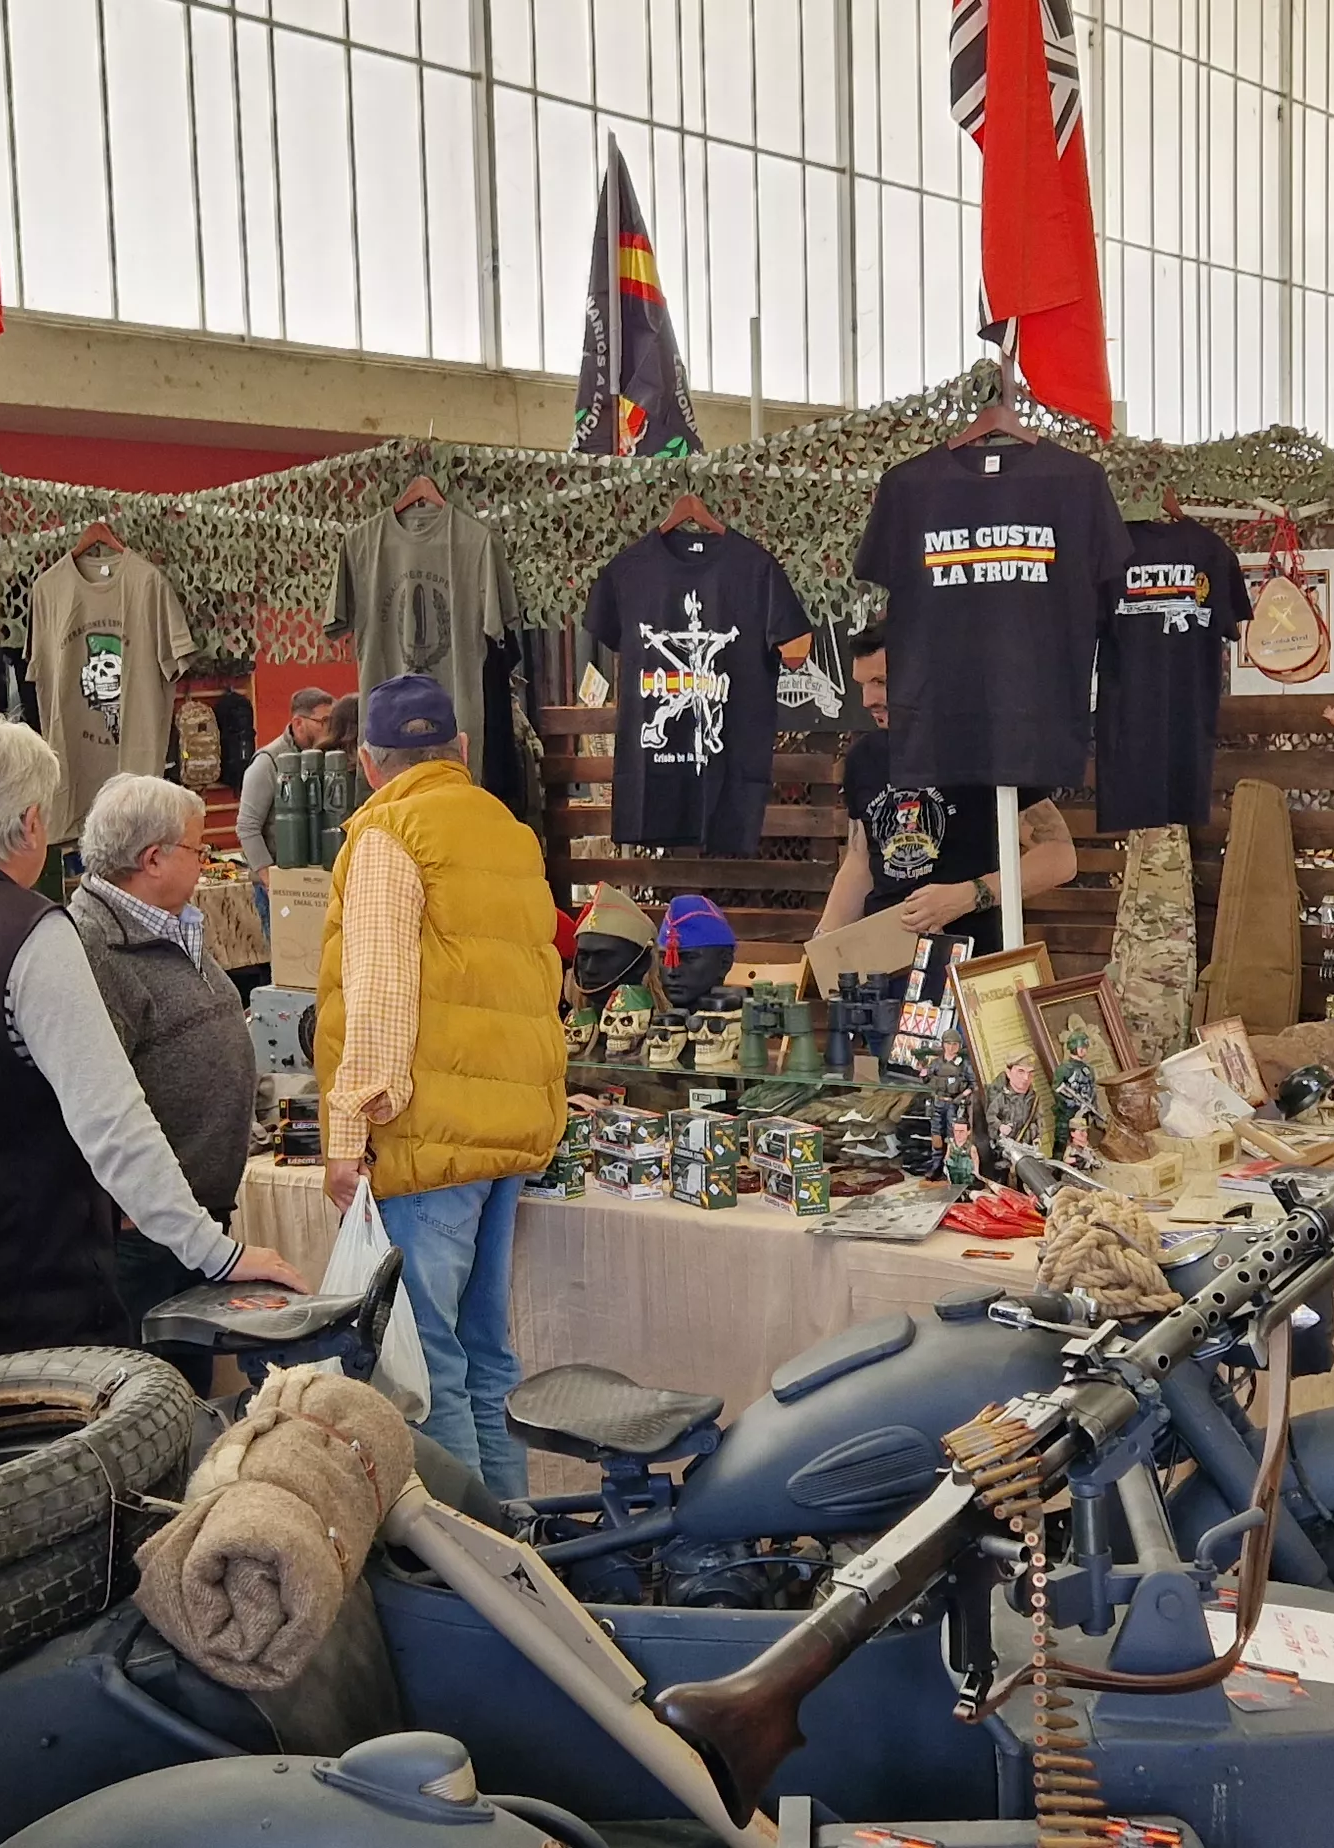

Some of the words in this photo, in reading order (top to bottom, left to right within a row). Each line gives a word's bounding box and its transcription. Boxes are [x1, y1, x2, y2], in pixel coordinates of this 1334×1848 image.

[924, 528, 970, 553] ME
[975, 524, 1056, 548] GUSTA
[932, 564, 968, 587] LA
[972, 560, 1049, 583] FRUTA
[1126, 564, 1196, 589] CETME
